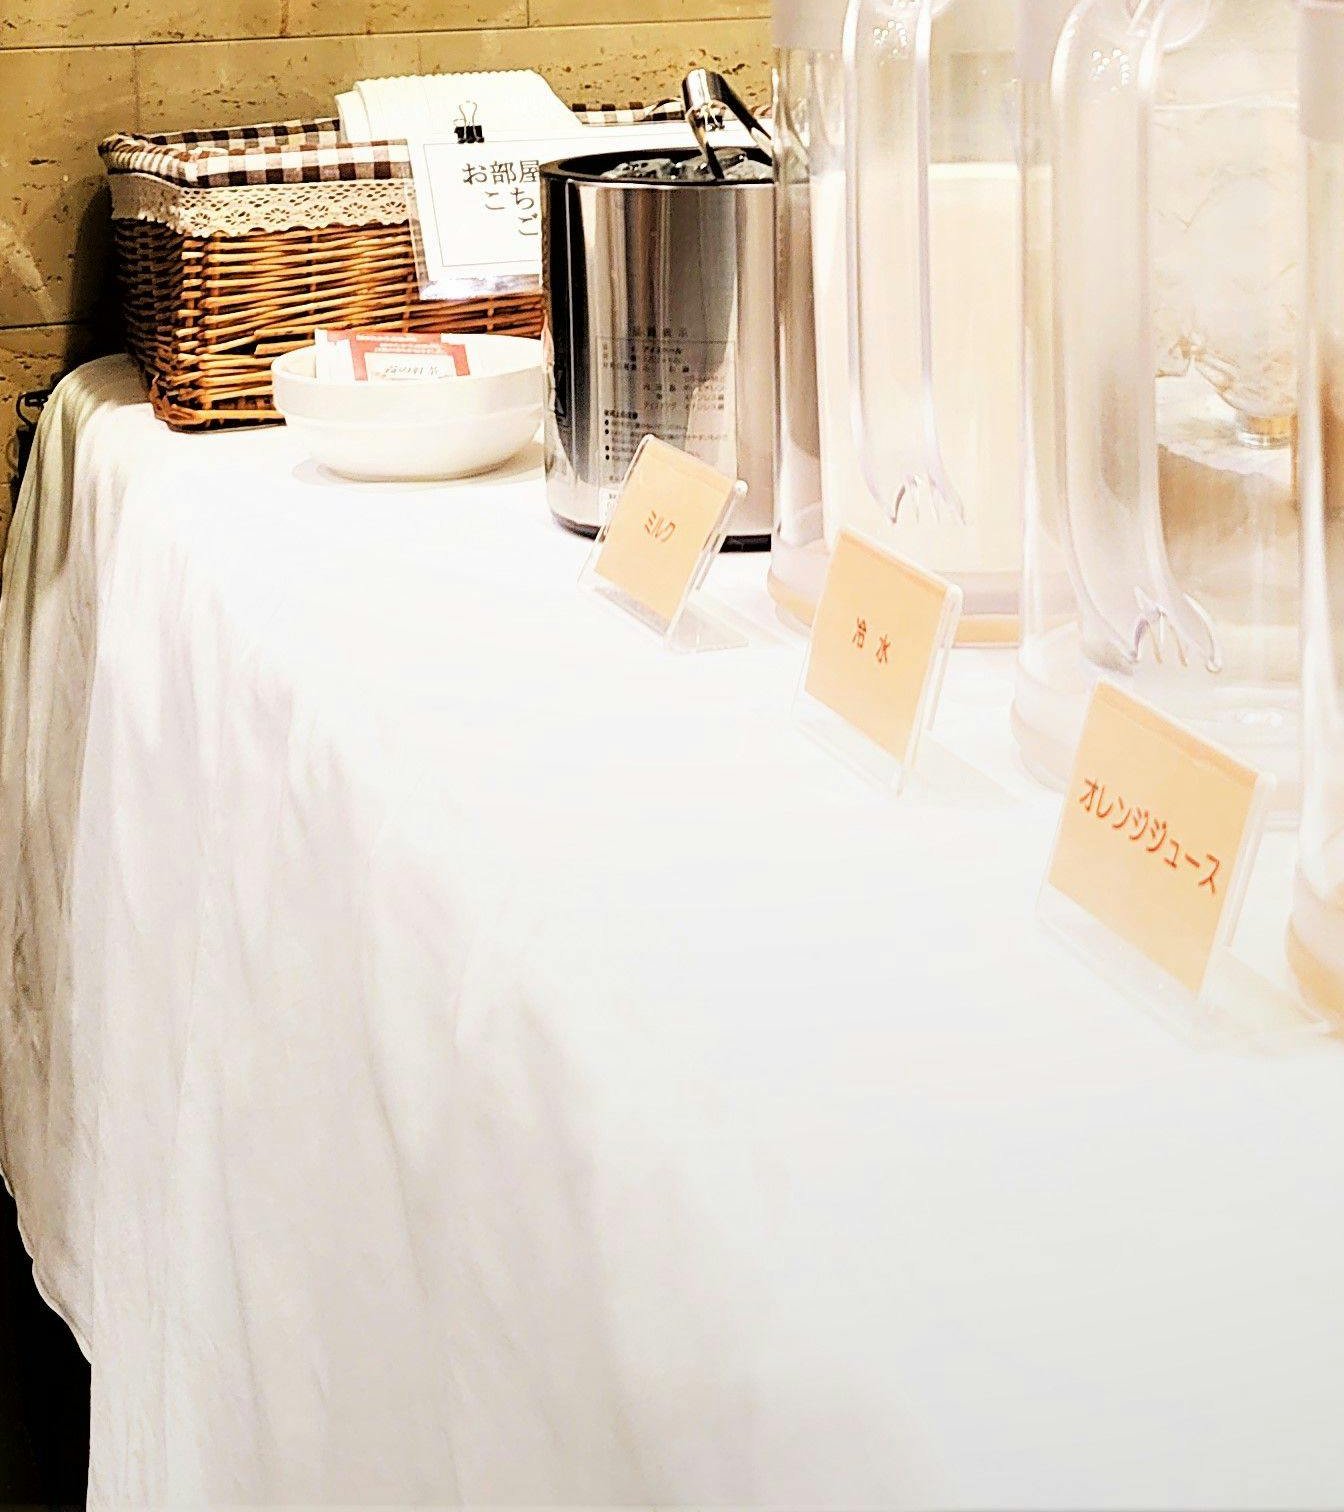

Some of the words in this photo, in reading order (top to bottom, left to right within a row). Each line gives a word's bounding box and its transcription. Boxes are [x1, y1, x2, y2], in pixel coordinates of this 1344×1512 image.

[462, 159, 540, 185] お部屋
[484, 187, 535, 211] こち
[517, 212, 539, 236] ご
[851, 616, 892, 664] 冷水
[1079, 778, 1220, 894] オレンジジュース
